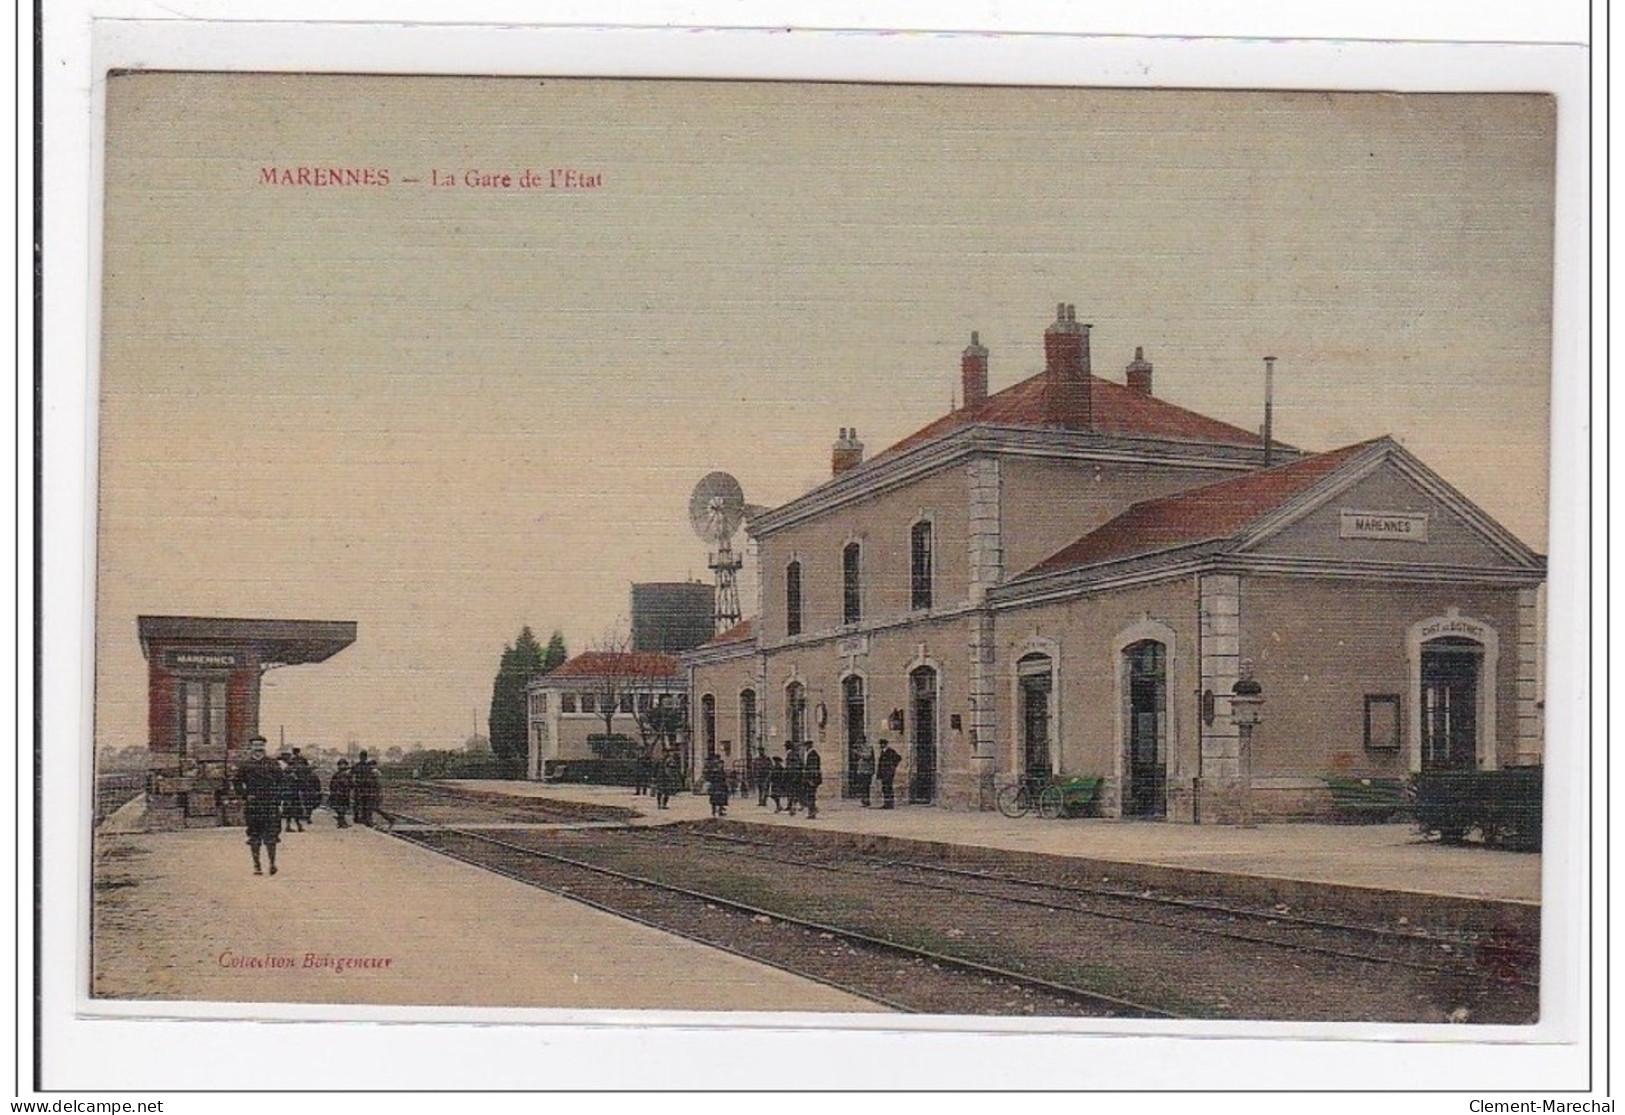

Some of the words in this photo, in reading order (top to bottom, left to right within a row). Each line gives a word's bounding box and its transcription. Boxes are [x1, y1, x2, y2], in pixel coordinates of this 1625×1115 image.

[259, 168, 390, 187] MARENNES
[431, 168, 456, 187] La
[464, 169, 511, 188] Gare
[519, 169, 542, 188] de
[1355, 518, 1412, 533] MARENNES
[218, 951, 296, 969] Collection
